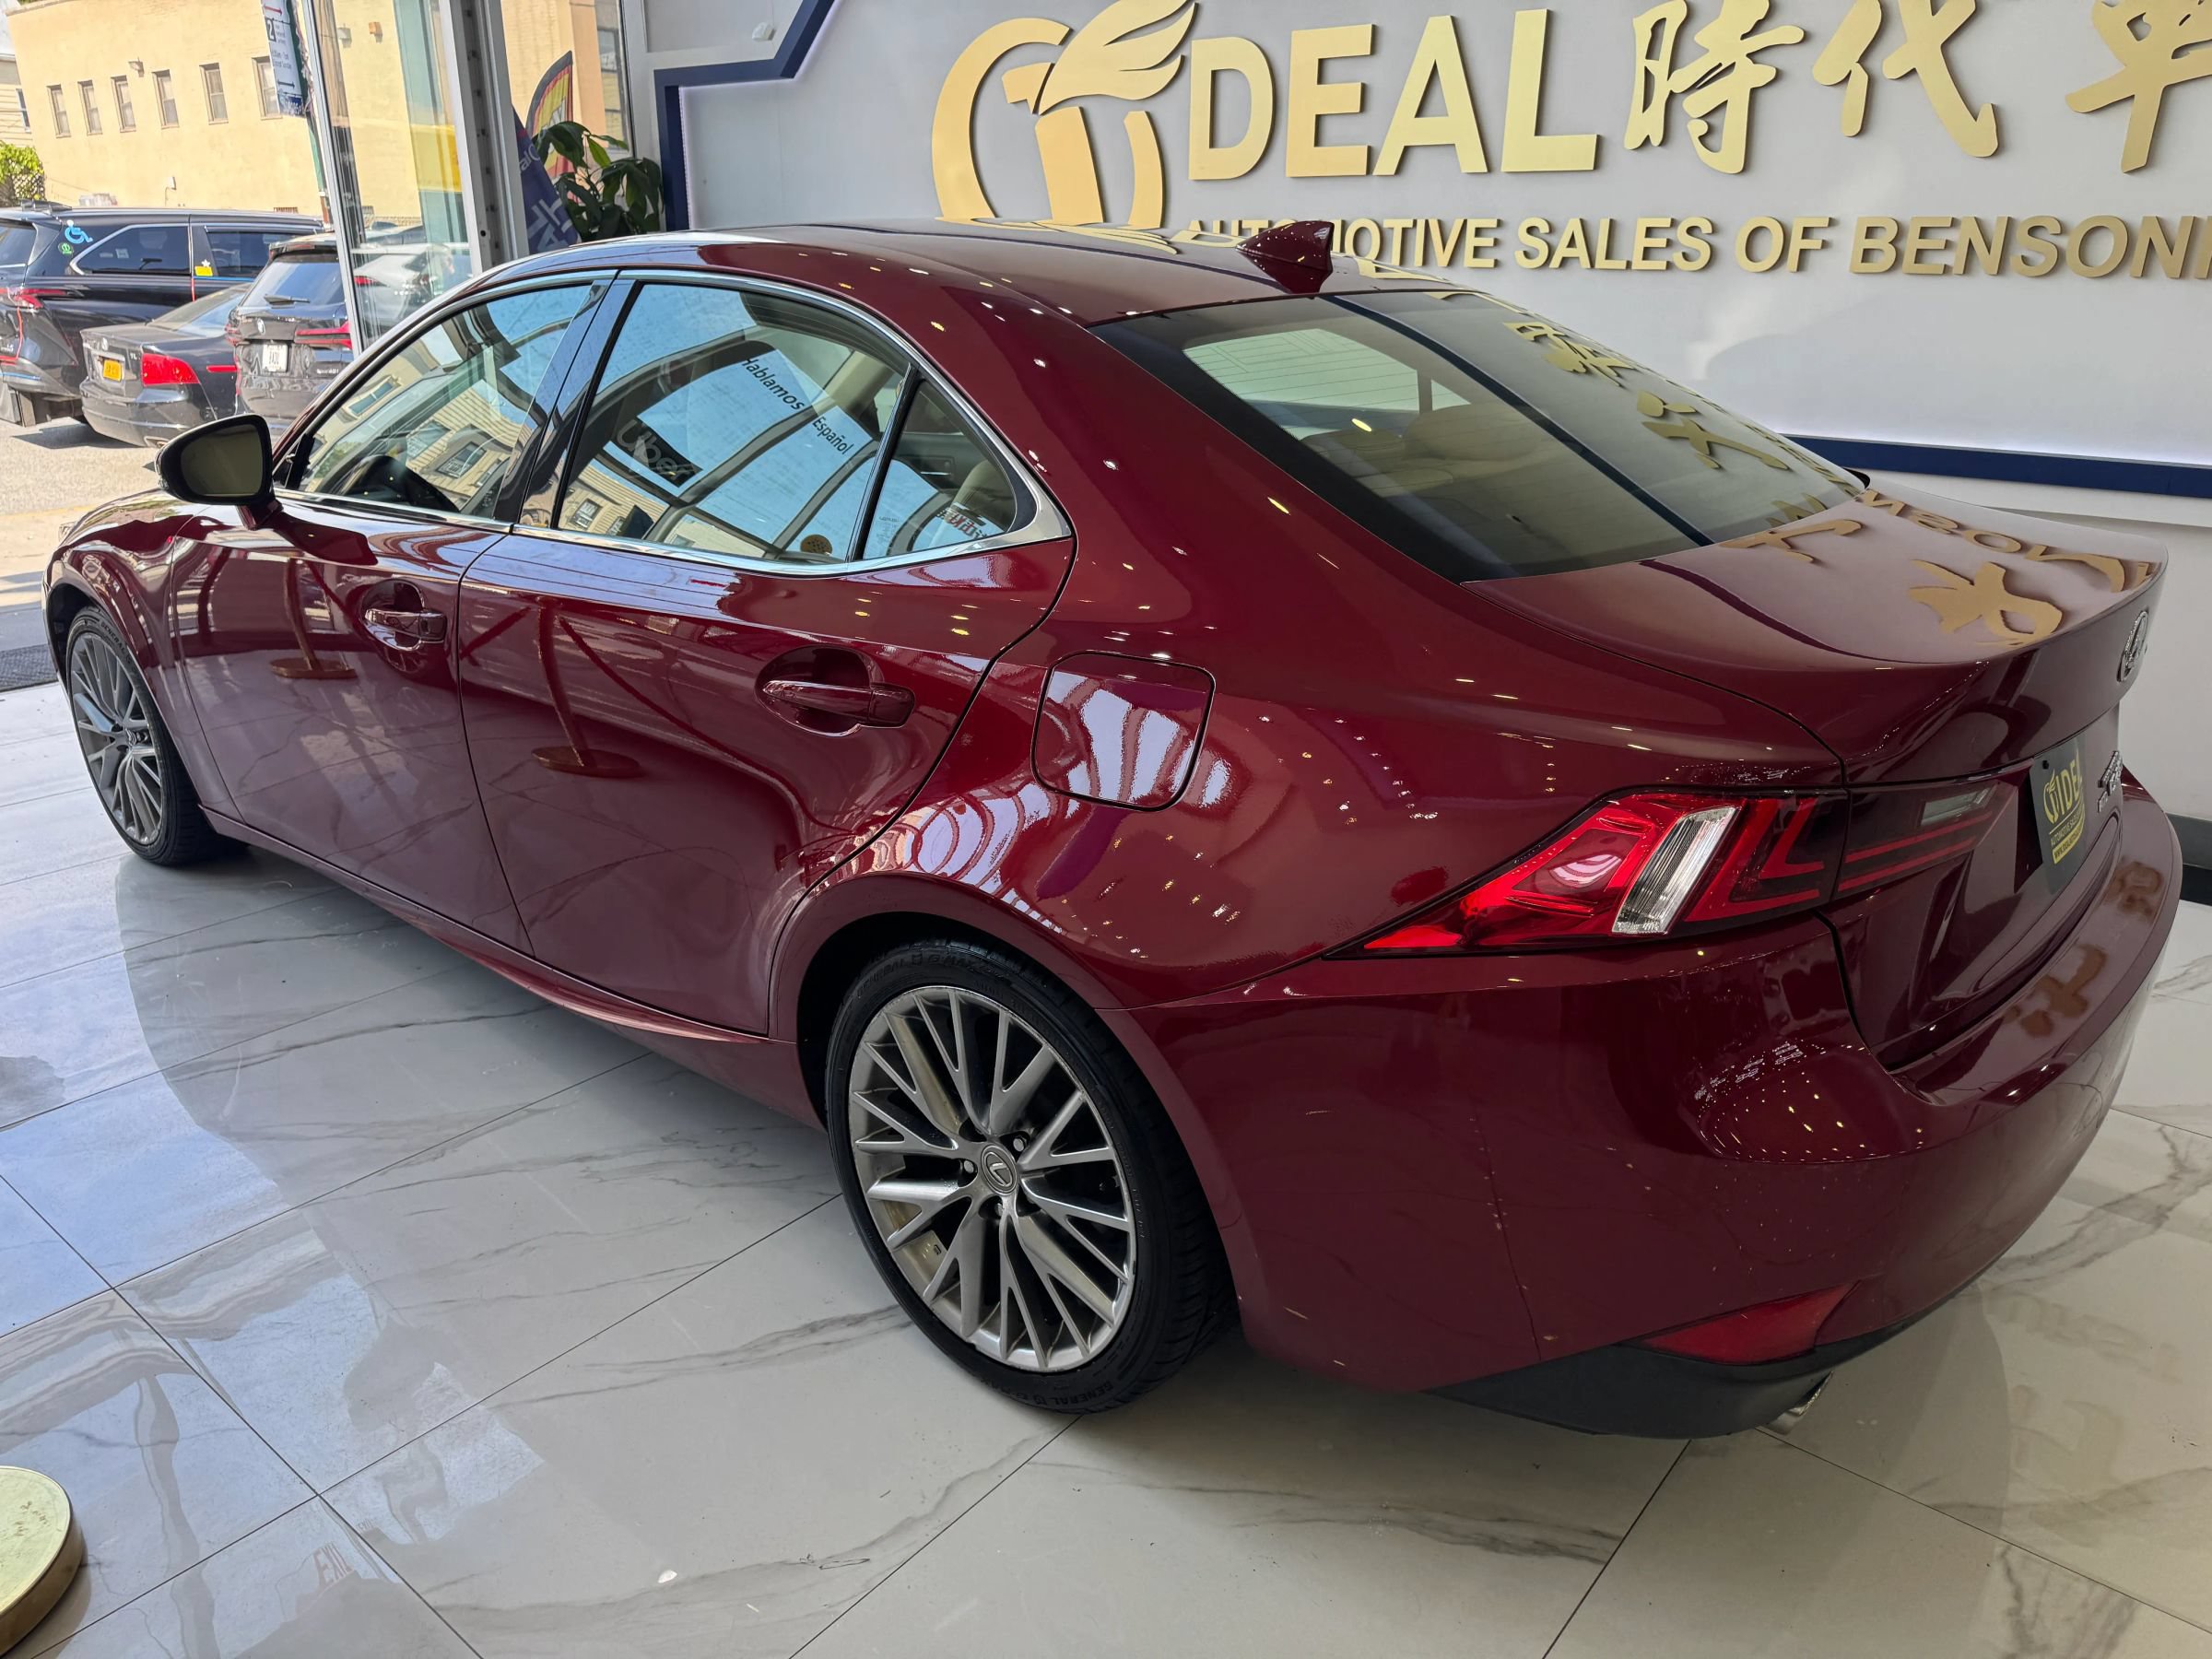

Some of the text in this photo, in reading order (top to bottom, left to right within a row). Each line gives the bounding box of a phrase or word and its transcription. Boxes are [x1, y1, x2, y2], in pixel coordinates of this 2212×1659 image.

[1514, 217, 1712, 271] SALES
[1735, 216, 1830, 273] OF
[1849, 214, 2212, 280] BENSON
[742, 359, 855, 454] Hablamos Español
[1050, 1381, 1114, 1406] GENERAL
